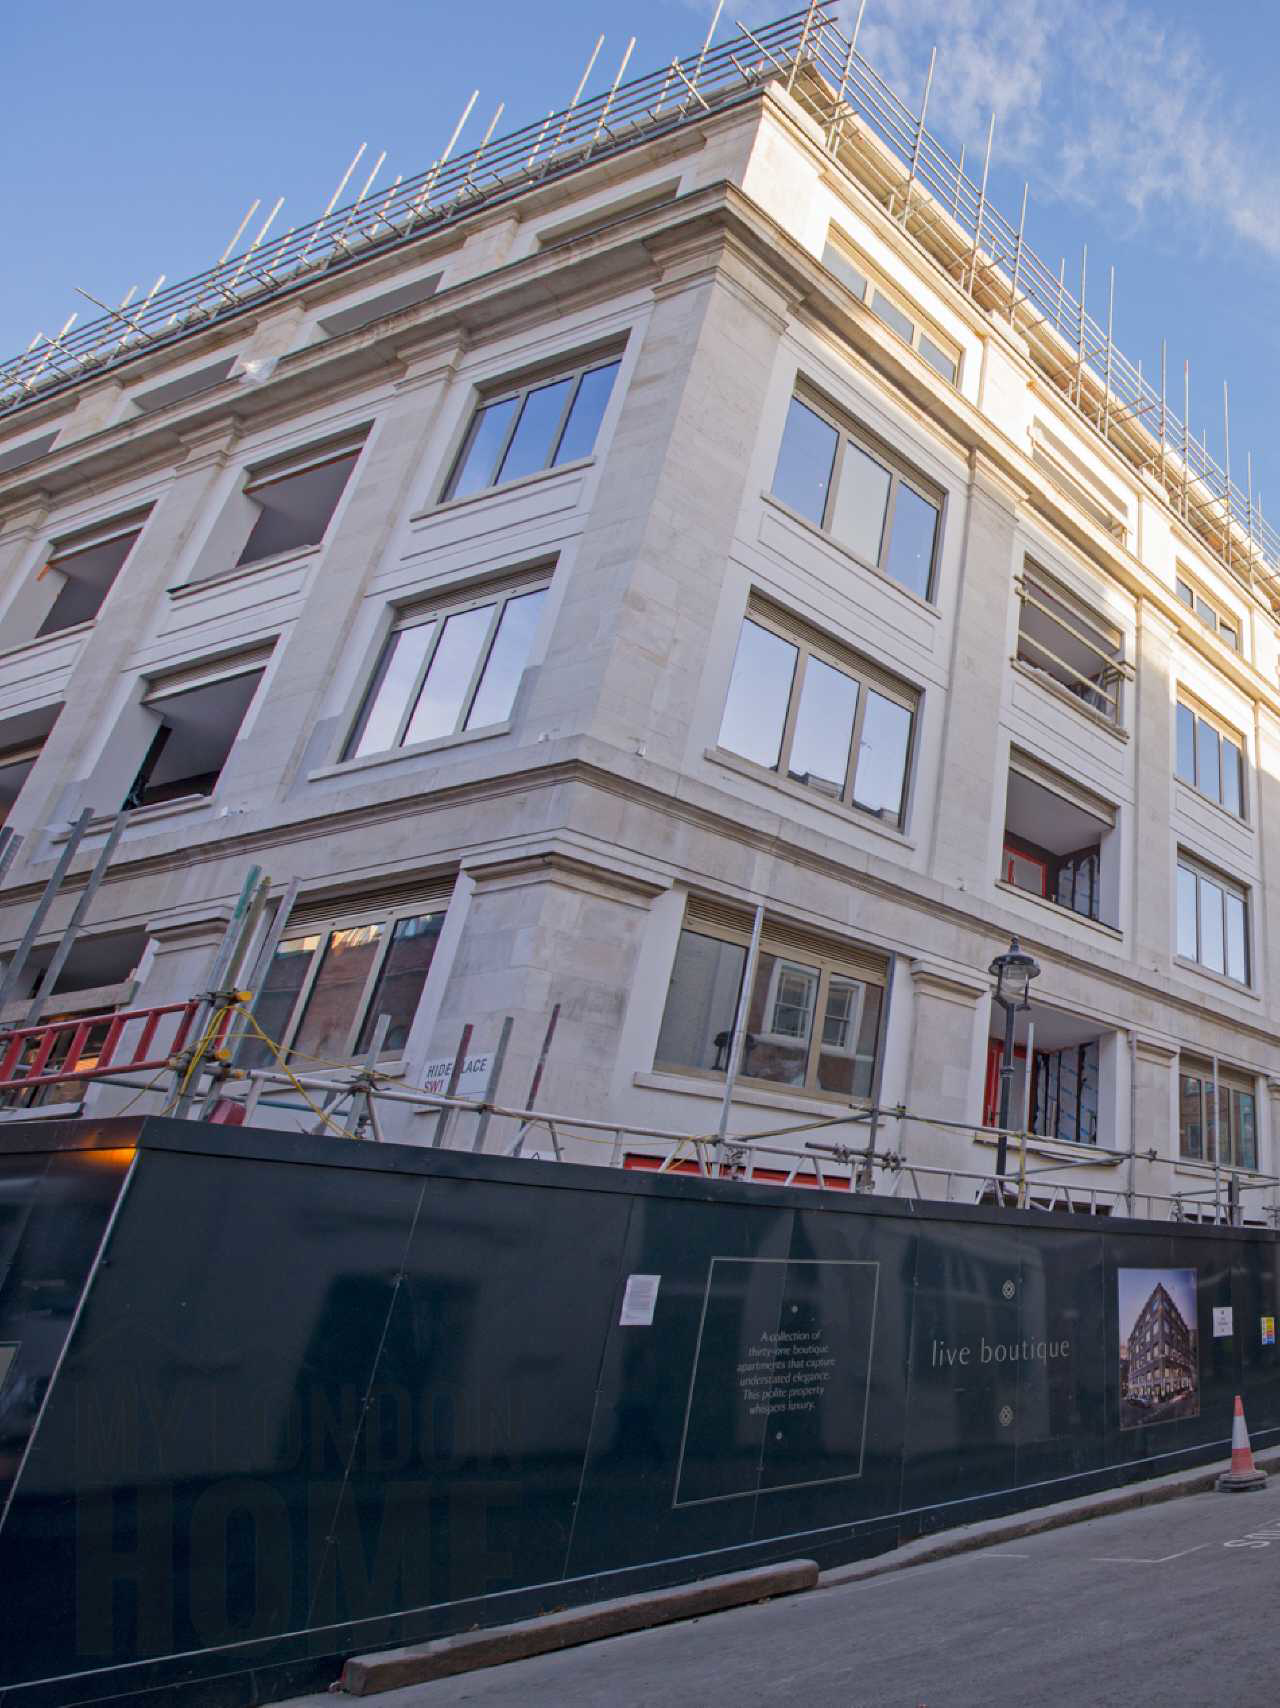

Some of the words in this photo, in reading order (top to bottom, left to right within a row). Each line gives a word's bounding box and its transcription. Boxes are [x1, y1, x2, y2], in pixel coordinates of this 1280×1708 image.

[426, 1062, 453, 1078] HIDE
[769, 1330, 810, 1343] collection
[811, 1329, 823, 1341] of
[793, 1343, 830, 1356] boutique
[932, 1339, 971, 1368] live
[980, 1336, 1070, 1366] boutique
[736, 1361, 786, 1373] apartments
[788, 1359, 805, 1369] that
[806, 1358, 837, 1370] capture
[740, 1373, 790, 1386] understated
[744, 1388, 760, 1401] This
[788, 1386, 825, 1400] property
[749, 1402, 786, 1415] whispers
